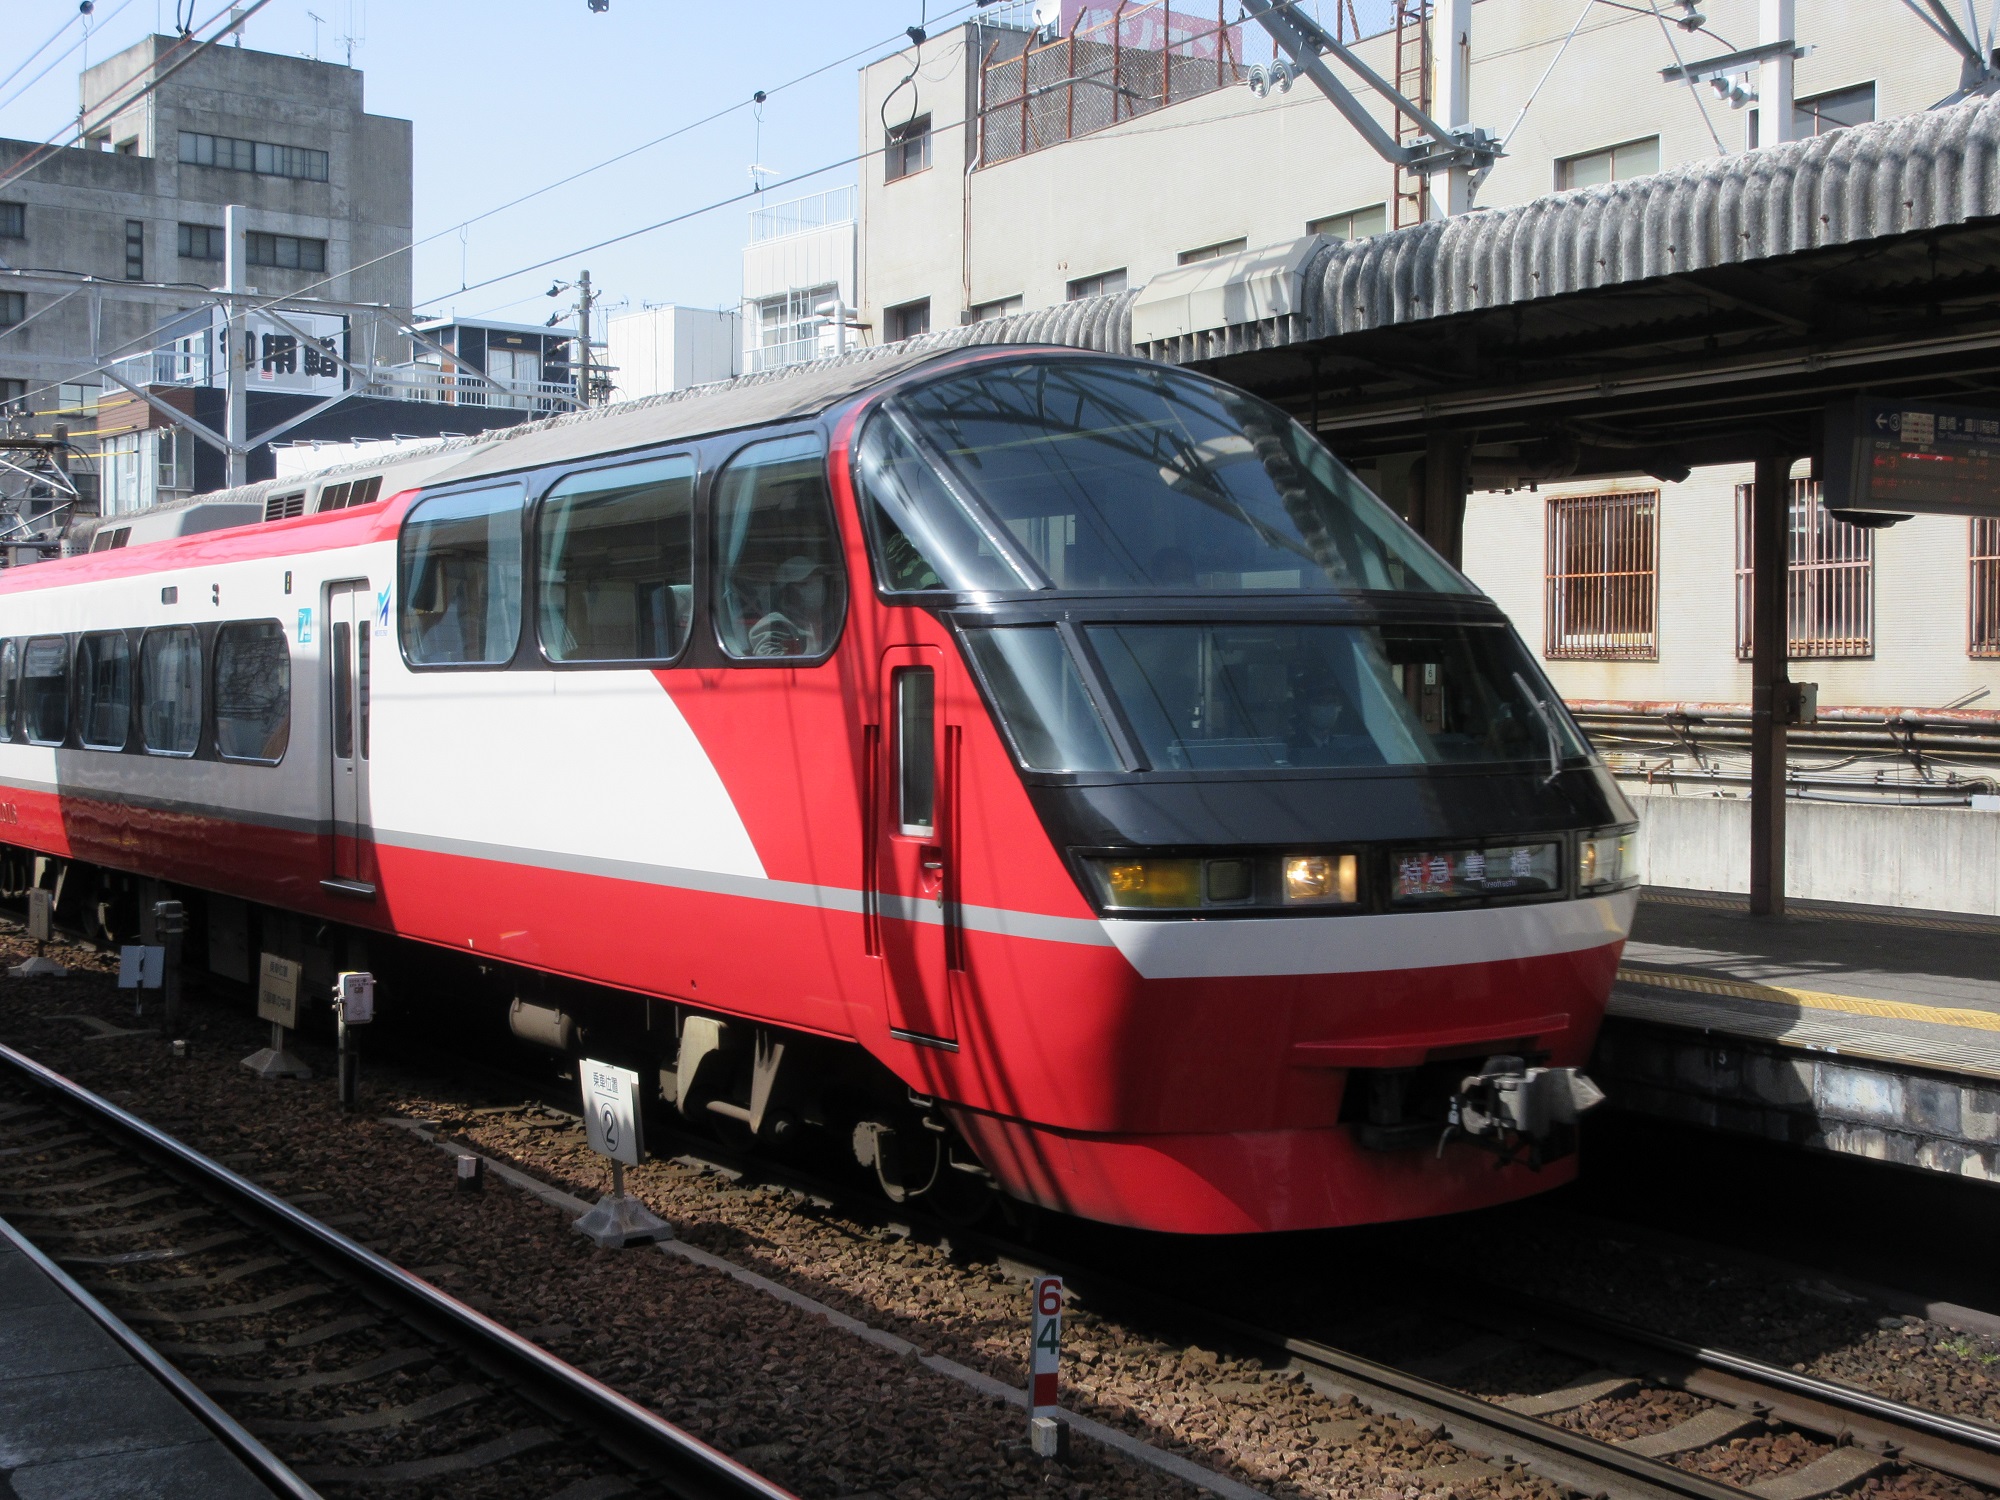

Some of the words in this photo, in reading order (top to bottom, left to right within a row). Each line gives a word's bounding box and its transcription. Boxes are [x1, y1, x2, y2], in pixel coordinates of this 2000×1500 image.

[1399, 854, 1451, 886] 特急
[1038, 1278, 1062, 1316] 6
[1036, 1317, 1060, 1355] 4
